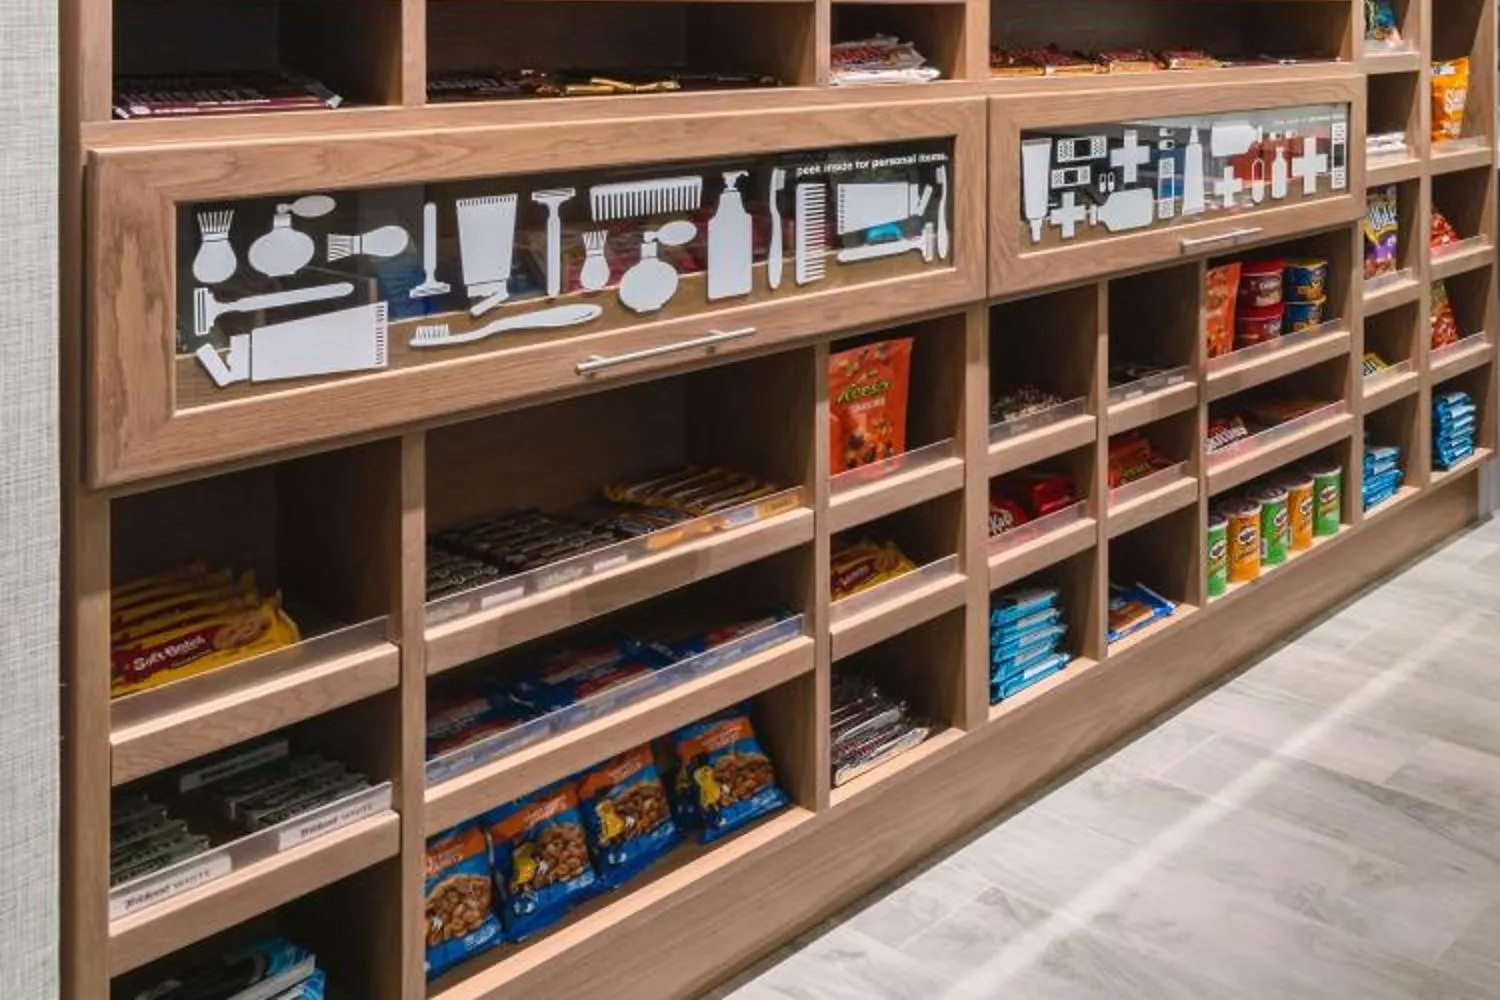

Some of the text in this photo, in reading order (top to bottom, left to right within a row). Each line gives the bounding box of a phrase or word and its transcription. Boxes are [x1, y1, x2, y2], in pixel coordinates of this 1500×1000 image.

[823, 161, 853, 173] inside
[856, 159, 870, 169] for
[871, 153, 917, 170] personal
